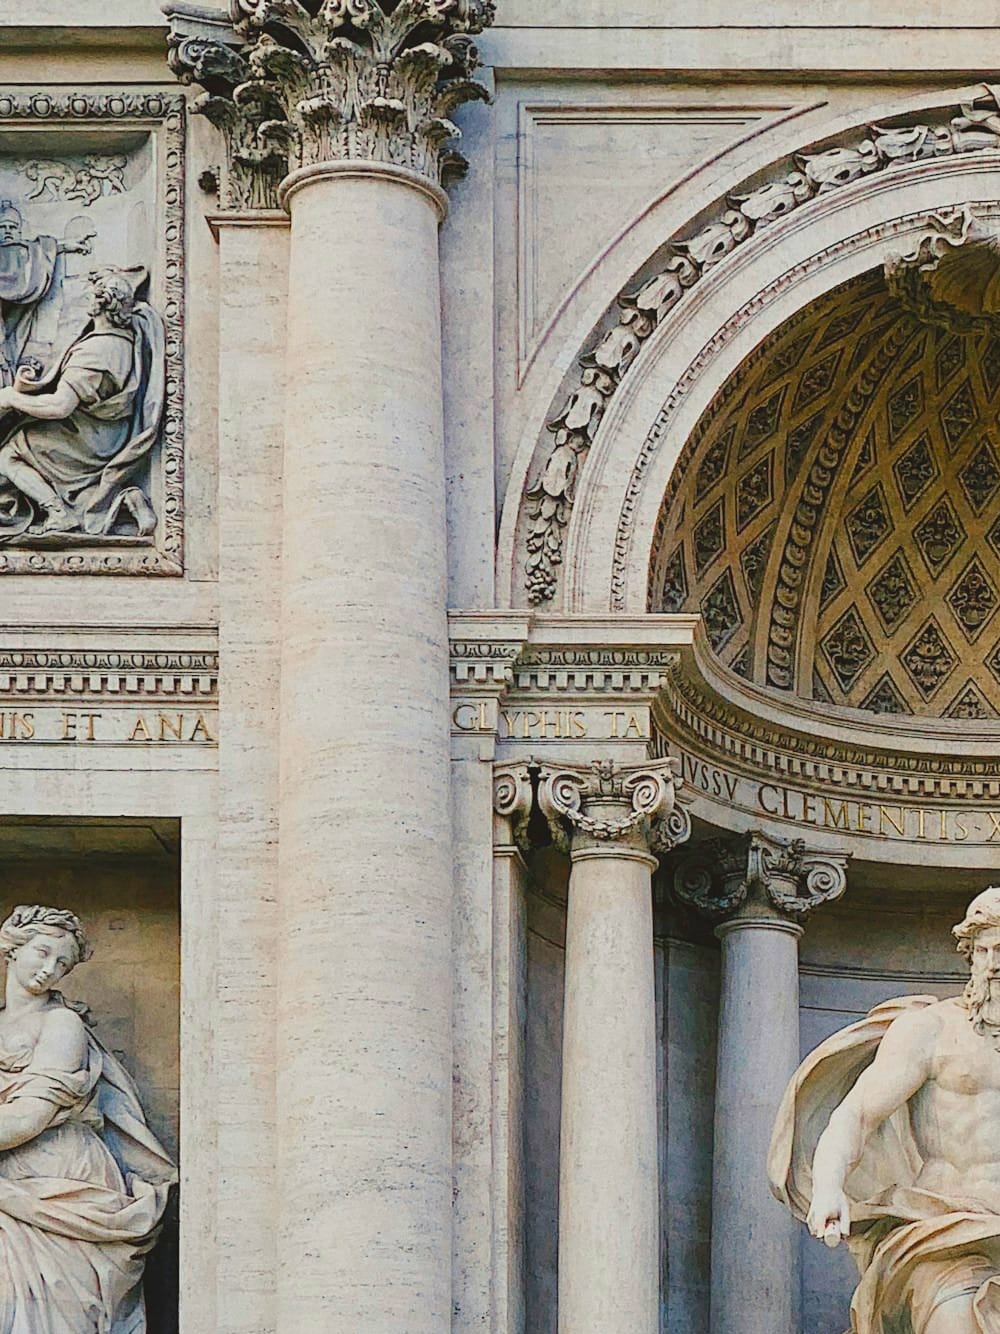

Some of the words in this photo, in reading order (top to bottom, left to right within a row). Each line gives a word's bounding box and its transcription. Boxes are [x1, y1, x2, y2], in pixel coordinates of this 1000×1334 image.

[62, 712, 102, 741] ET
[128, 711, 214, 741] ANA
[680, 752, 739, 801] IVSSV
[757, 784, 968, 842] CLEMENTIS
